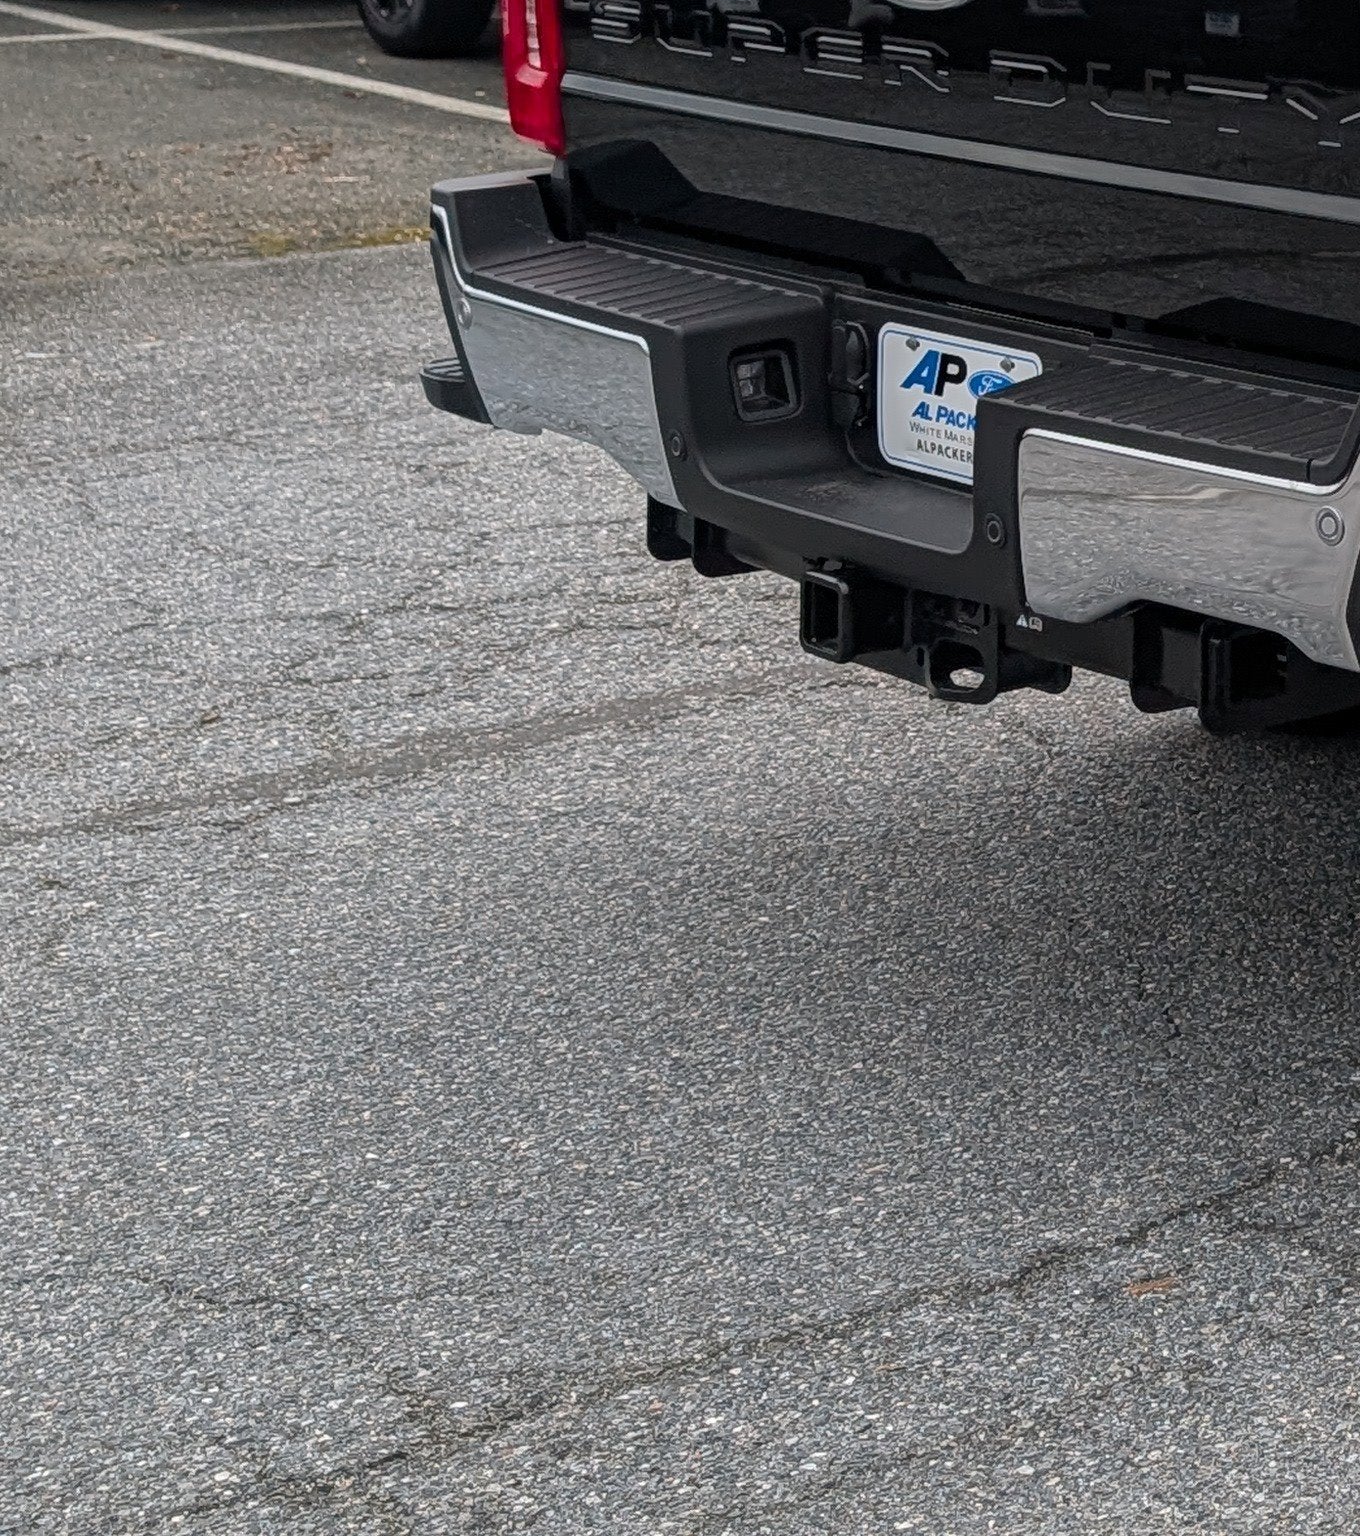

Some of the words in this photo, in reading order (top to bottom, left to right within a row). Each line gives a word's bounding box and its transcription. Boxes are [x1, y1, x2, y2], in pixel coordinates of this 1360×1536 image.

[900, 349, 967, 396] AP
[912, 401, 932, 421] AL
[909, 421, 942, 439] WHITE
